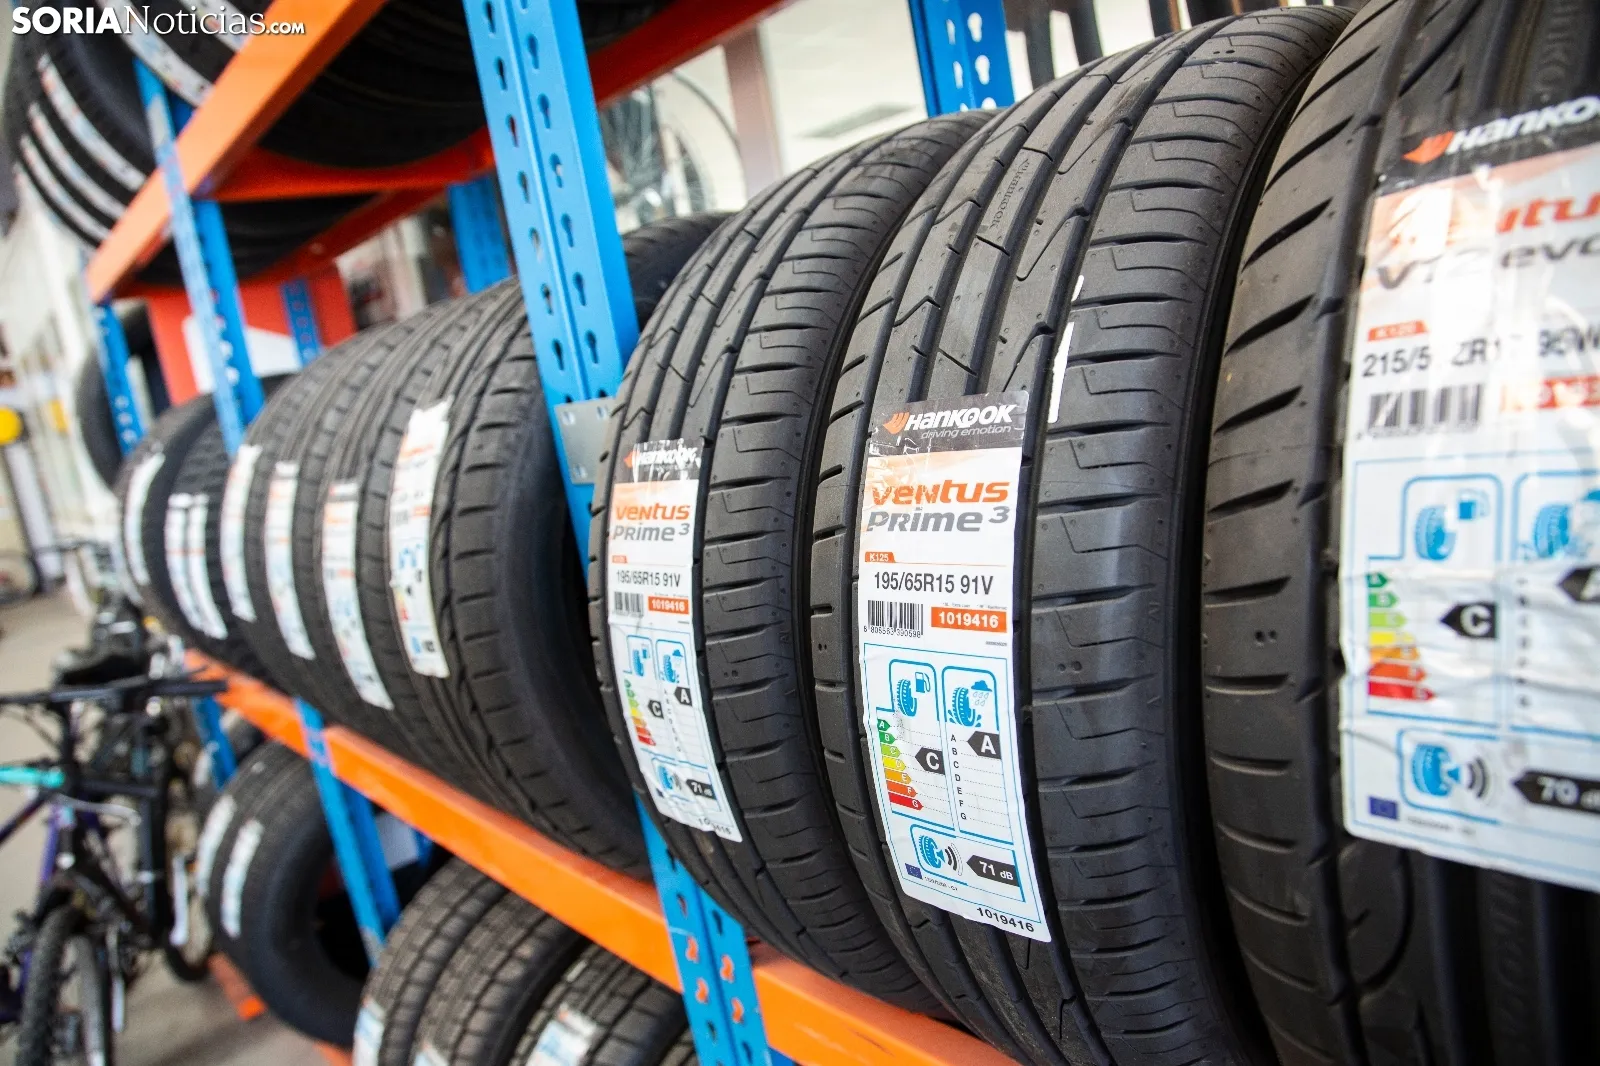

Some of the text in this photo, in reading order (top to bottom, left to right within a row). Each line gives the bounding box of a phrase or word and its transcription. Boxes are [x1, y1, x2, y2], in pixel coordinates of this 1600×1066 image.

[921, 424, 1012, 440] driving emotion
[869, 553, 889, 562] K125
[616, 570, 681, 588] 195/65R15 91V
[874, 571, 993, 595] 195/65R15 91V
[651, 599, 685, 612] 1019416
[938, 611, 999, 628] 1019416
[1459, 604, 1491, 636] C
[680, 689, 690, 704] A
[652, 702, 661, 716] C
[951, 734, 956, 742] A
[980, 735, 996, 755] A
[952, 747, 958, 756] B
[925, 752, 940, 770] C
[953, 760, 959, 769] C
[955, 774, 961, 782] D
[690, 782, 703, 794] 71
[957, 787, 963, 795] E
[1536, 776, 1579, 806] 70
[960, 812, 967, 821] G
[978, 861, 1014, 881] 71 dB
[976, 907, 1035, 933] 1019416
